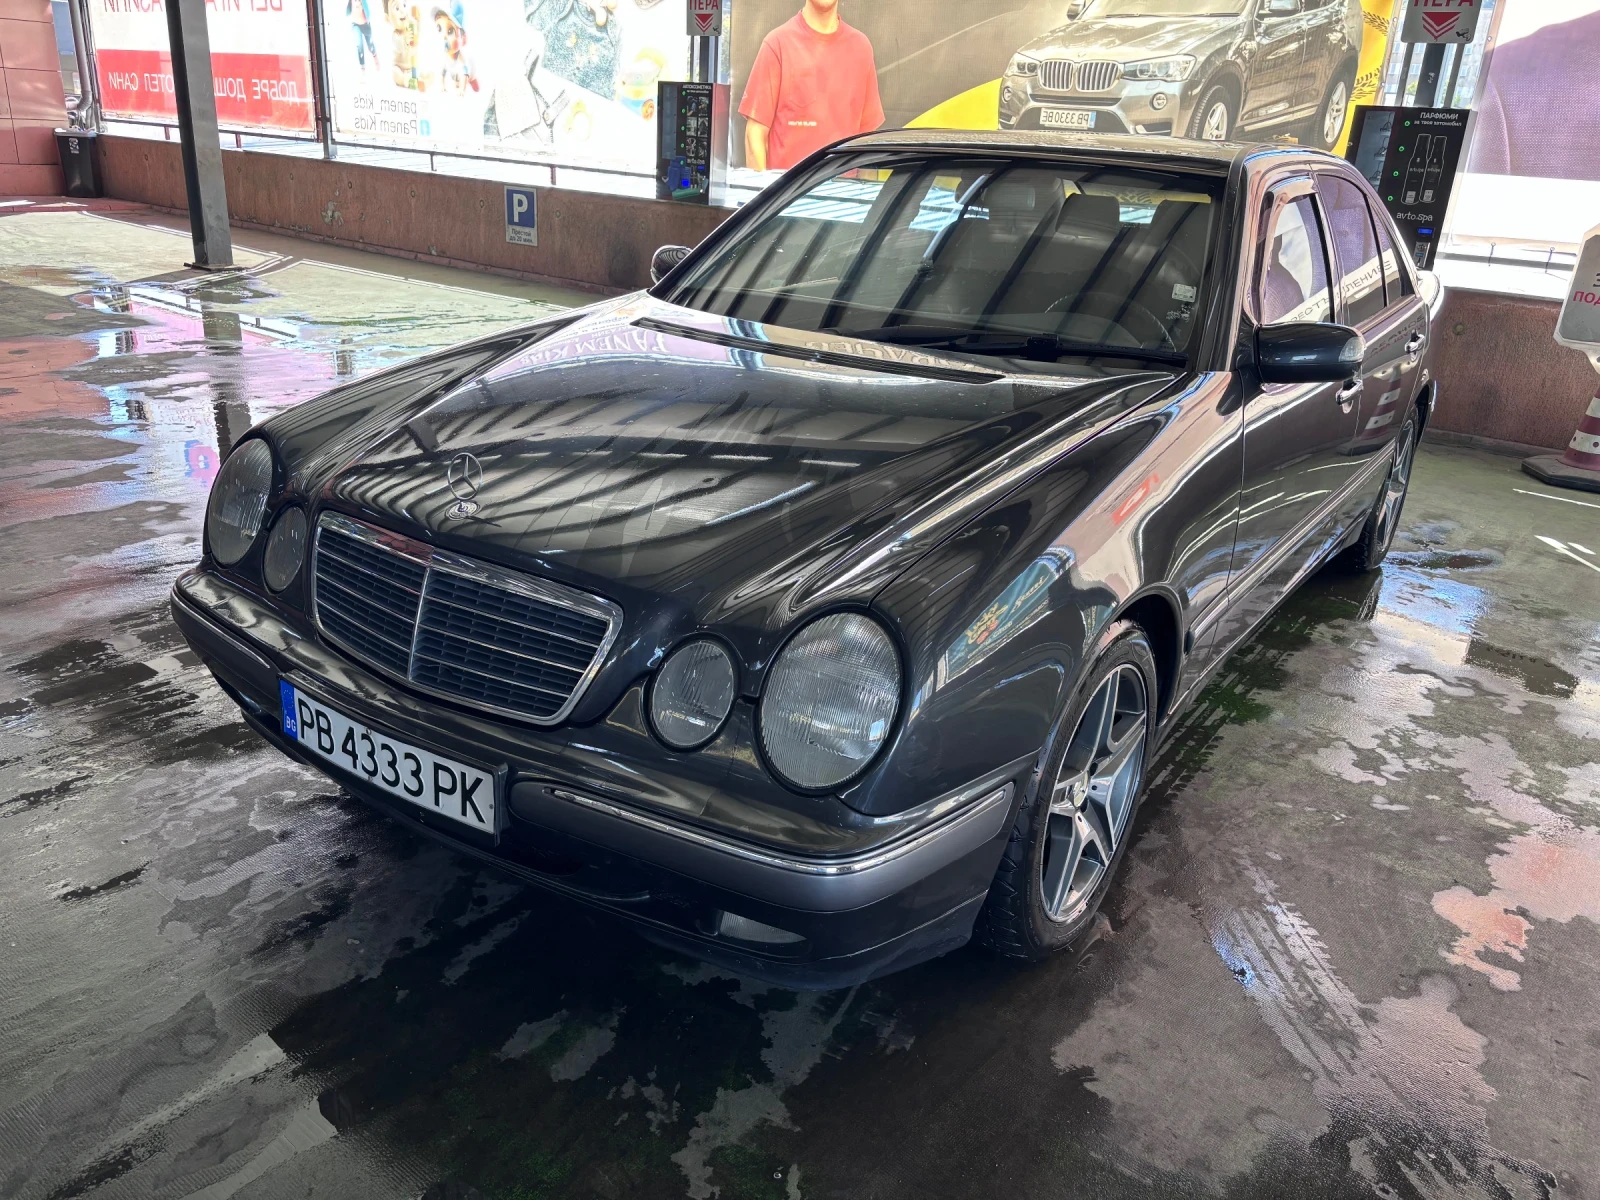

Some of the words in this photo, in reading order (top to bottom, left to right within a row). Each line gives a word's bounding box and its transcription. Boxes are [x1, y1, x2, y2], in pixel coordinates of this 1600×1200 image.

[689, 0, 719, 10] ПЕРА
[513, 194, 528, 222] P
[285, 715, 297, 732] BG
[297, 698, 335, 755] PB
[341, 726, 425, 797] 4333
[433, 761, 487, 824] PK
